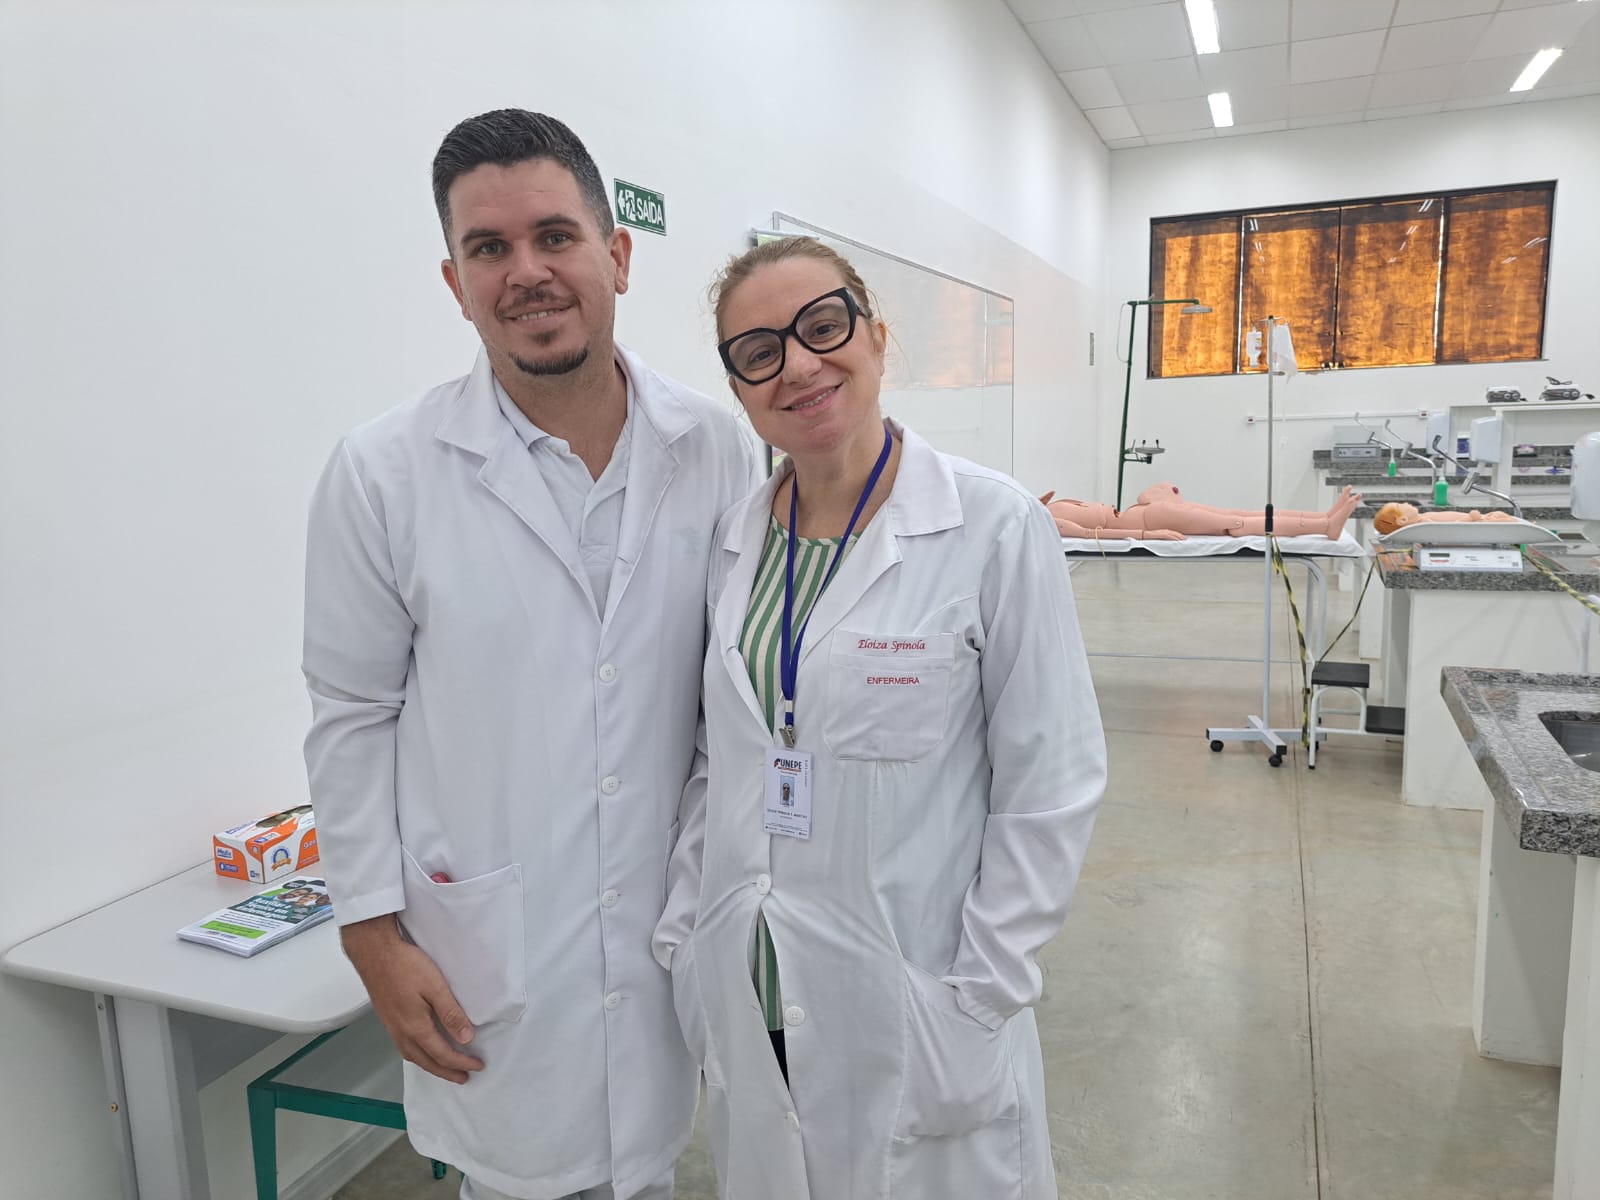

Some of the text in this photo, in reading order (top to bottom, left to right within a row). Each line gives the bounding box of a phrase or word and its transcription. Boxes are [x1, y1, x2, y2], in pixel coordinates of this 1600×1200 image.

[636, 195, 664, 226] SAÍDA
[858, 639, 926, 653] Eloiza Spinola
[866, 676, 920, 685] ENFERMEIRA
[774, 758, 802, 770] FUNEPE
